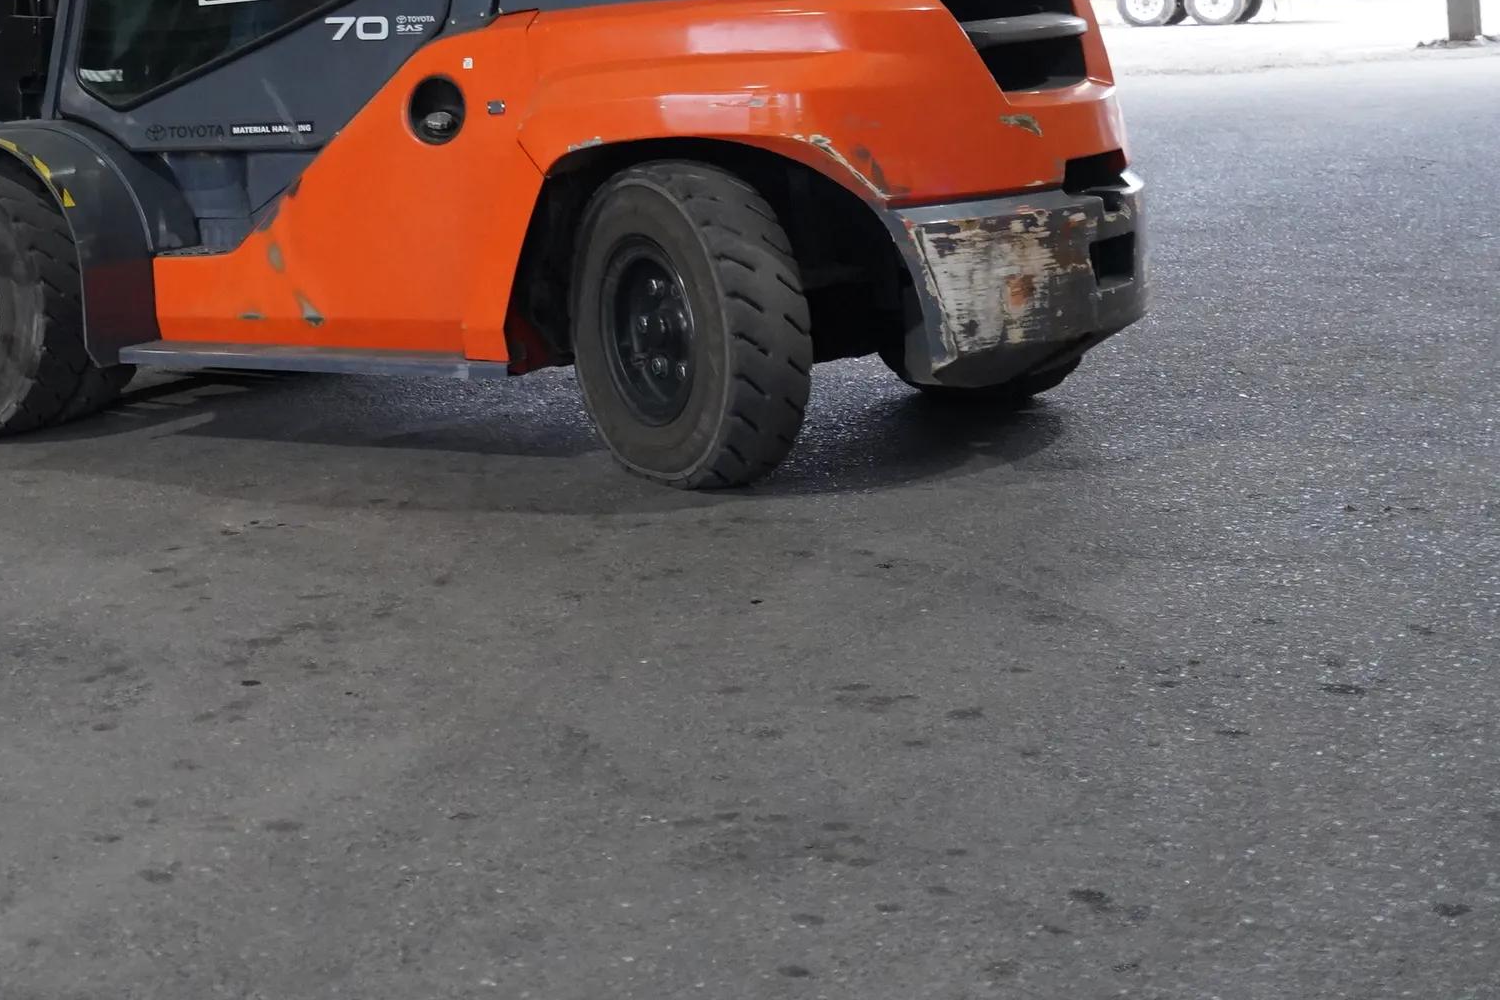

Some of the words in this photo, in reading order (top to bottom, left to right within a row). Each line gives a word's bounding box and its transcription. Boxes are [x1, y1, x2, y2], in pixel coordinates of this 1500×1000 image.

[407, 15, 436, 23] TOYOTA
[324, 16, 389, 41] 70
[396, 24, 424, 32] SAS
[169, 124, 225, 139] TOYOTA
[232, 126, 270, 135] MATERIAL
[272, 124, 312, 133] HANING
